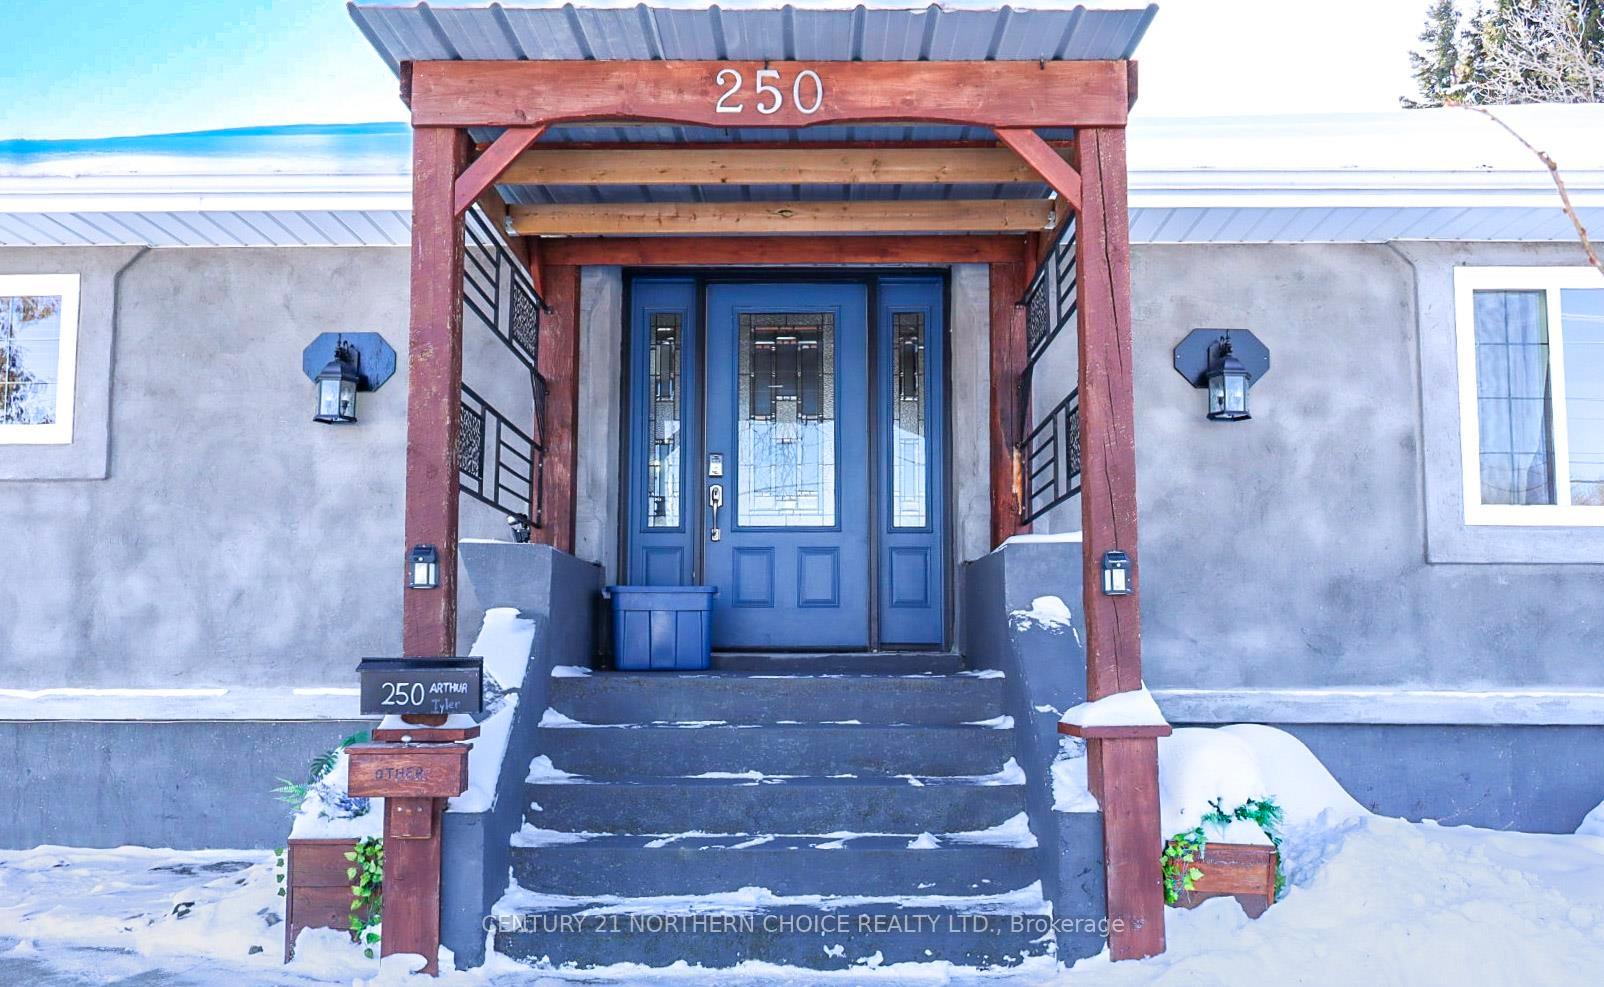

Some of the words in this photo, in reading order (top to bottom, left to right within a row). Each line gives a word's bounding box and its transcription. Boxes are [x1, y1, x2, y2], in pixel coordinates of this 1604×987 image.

[715, 68, 823, 115] 250
[380, 682, 425, 706] 250
[429, 682, 468, 694] ARTHUR
[431, 698, 461, 714] Tyler
[375, 767, 424, 781] OTHER
